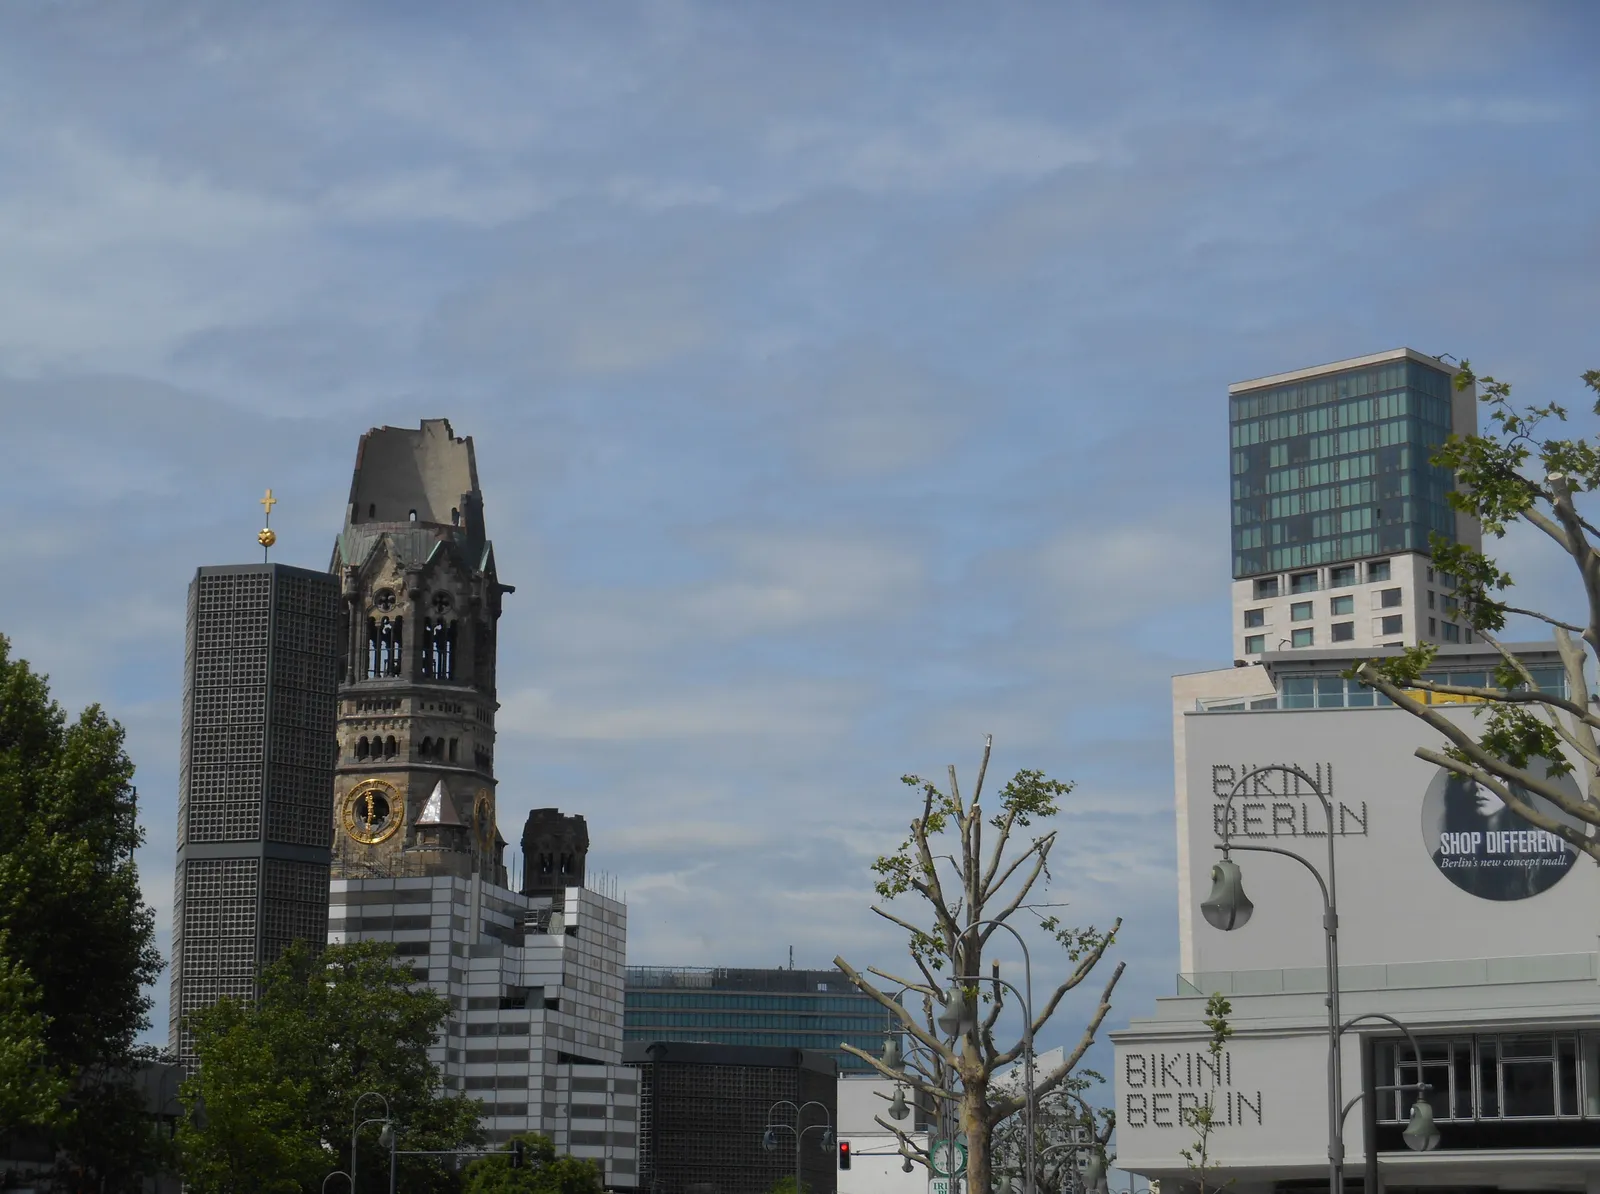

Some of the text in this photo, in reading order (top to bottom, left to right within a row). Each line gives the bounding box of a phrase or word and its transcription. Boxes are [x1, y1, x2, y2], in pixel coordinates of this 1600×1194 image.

[1212, 762, 1333, 799] BIKINI
[1213, 801, 1368, 839] BERLIN
[1440, 831, 1481, 856] SHOP
[1441, 855, 1568, 869] Berlin's new concept mall.
[1126, 1051, 1231, 1089] BIKINI
[1126, 1090, 1262, 1128] BERLIN
